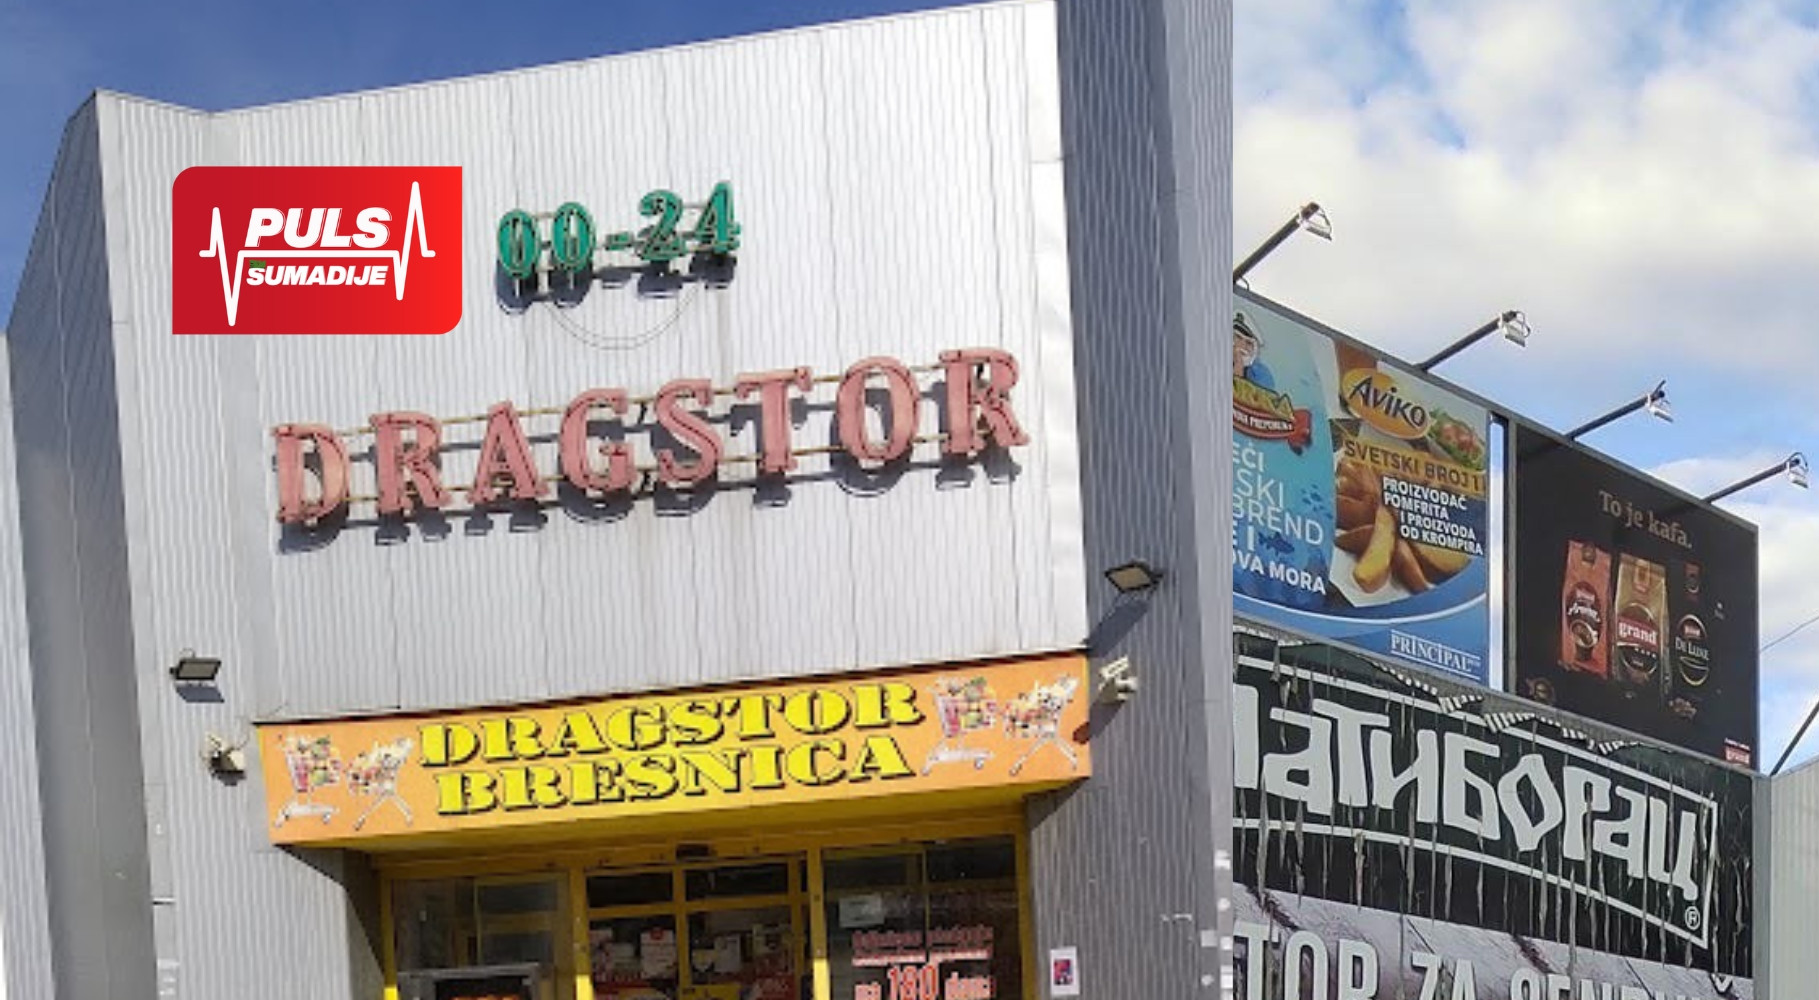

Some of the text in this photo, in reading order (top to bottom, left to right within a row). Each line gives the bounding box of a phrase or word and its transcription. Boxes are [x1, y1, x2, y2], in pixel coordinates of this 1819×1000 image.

[497, 180, 741, 283] 00-24
[273, 348, 1029, 525] DRAGSTOR
[1344, 440, 1420, 476] SVETSKI
[1424, 463, 1468, 489] BROJ
[1232, 493, 1324, 546] BREND
[1383, 491, 1450, 521] POMFRITA
[1407, 512, 1477, 541] PROIZVODA
[1599, 490, 1693, 549] To je kafa.
[1400, 524, 1485, 557] OD KROMPIRA
[1232, 548, 1328, 597] VA MORA
[1391, 633, 1472, 673] PRINCIPAL
[1617, 621, 1659, 645] grand
[418, 681, 926, 770] DRAGSTOR
[435, 733, 918, 819] BRESNICA
